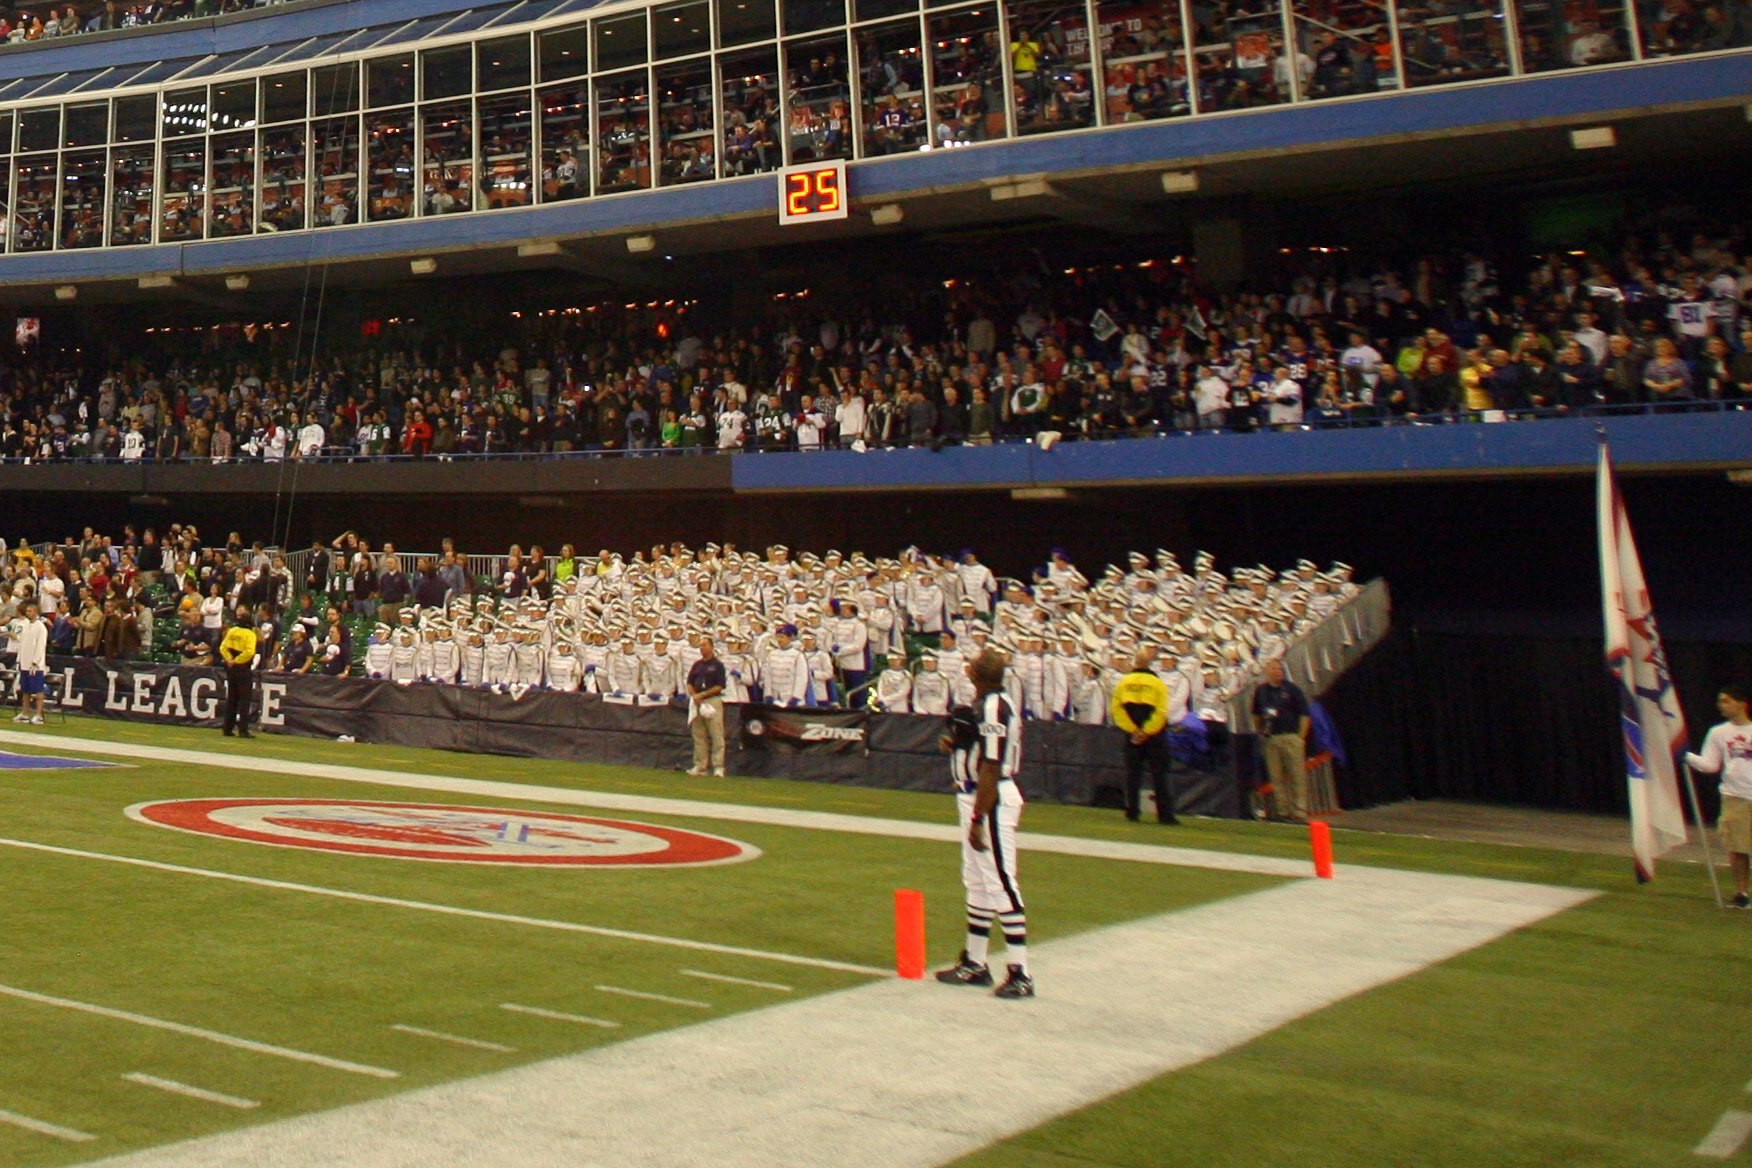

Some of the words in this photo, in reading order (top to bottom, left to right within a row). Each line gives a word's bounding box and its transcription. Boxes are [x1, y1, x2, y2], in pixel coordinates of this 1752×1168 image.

[789, 169, 839, 214] 25
[105, 670, 287, 725] LEAGE
[801, 723, 865, 741] ZONE
